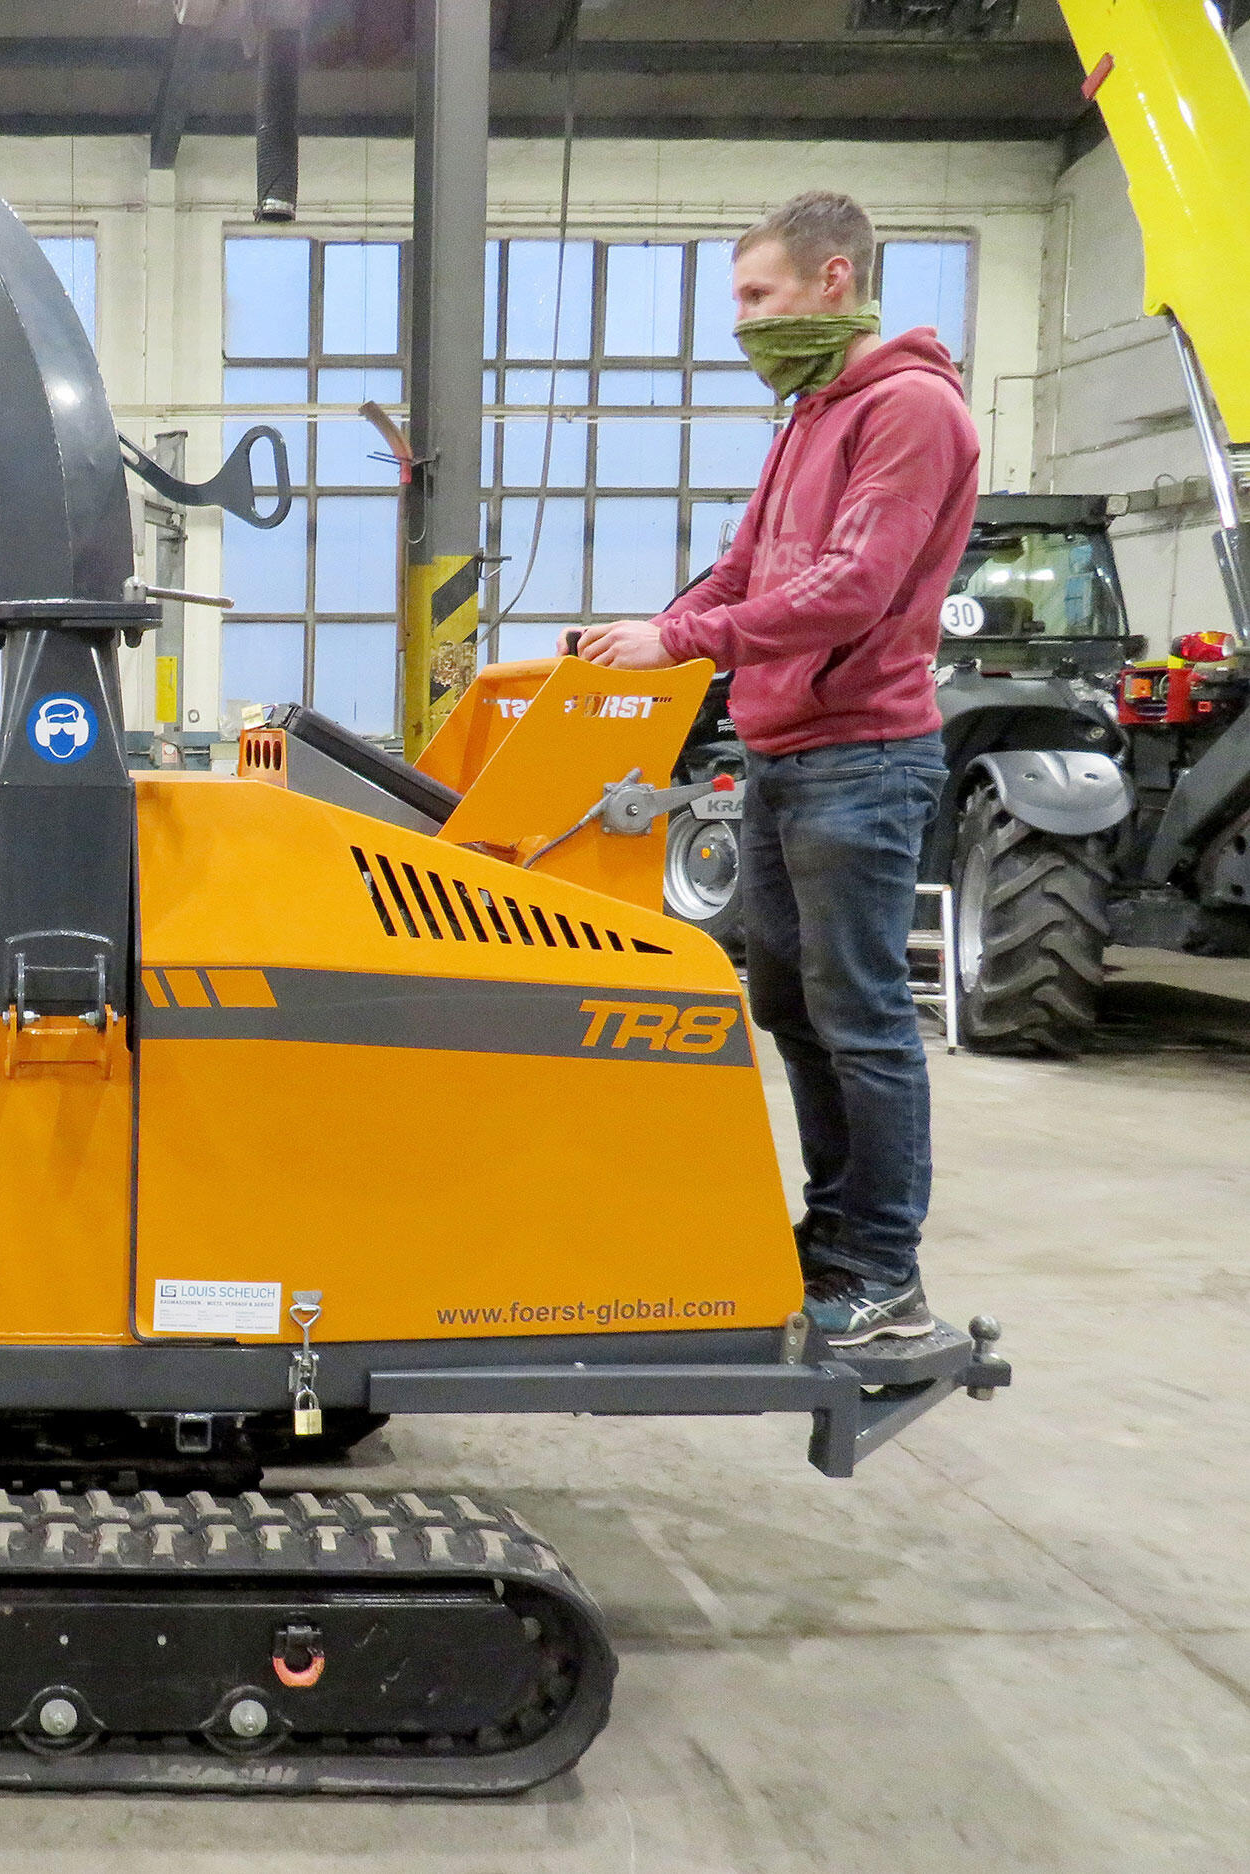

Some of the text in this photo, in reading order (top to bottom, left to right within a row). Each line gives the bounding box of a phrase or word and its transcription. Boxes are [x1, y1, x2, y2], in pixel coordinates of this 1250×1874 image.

[947, 603, 975, 627] 30
[707, 799, 744, 812] KRA
[579, 999, 738, 1055] TR8
[181, 1286, 216, 1298] LOUIS
[219, 1286, 276, 1298] SCHEUCH
[437, 1297, 736, 1327] www.foerst-global.com
